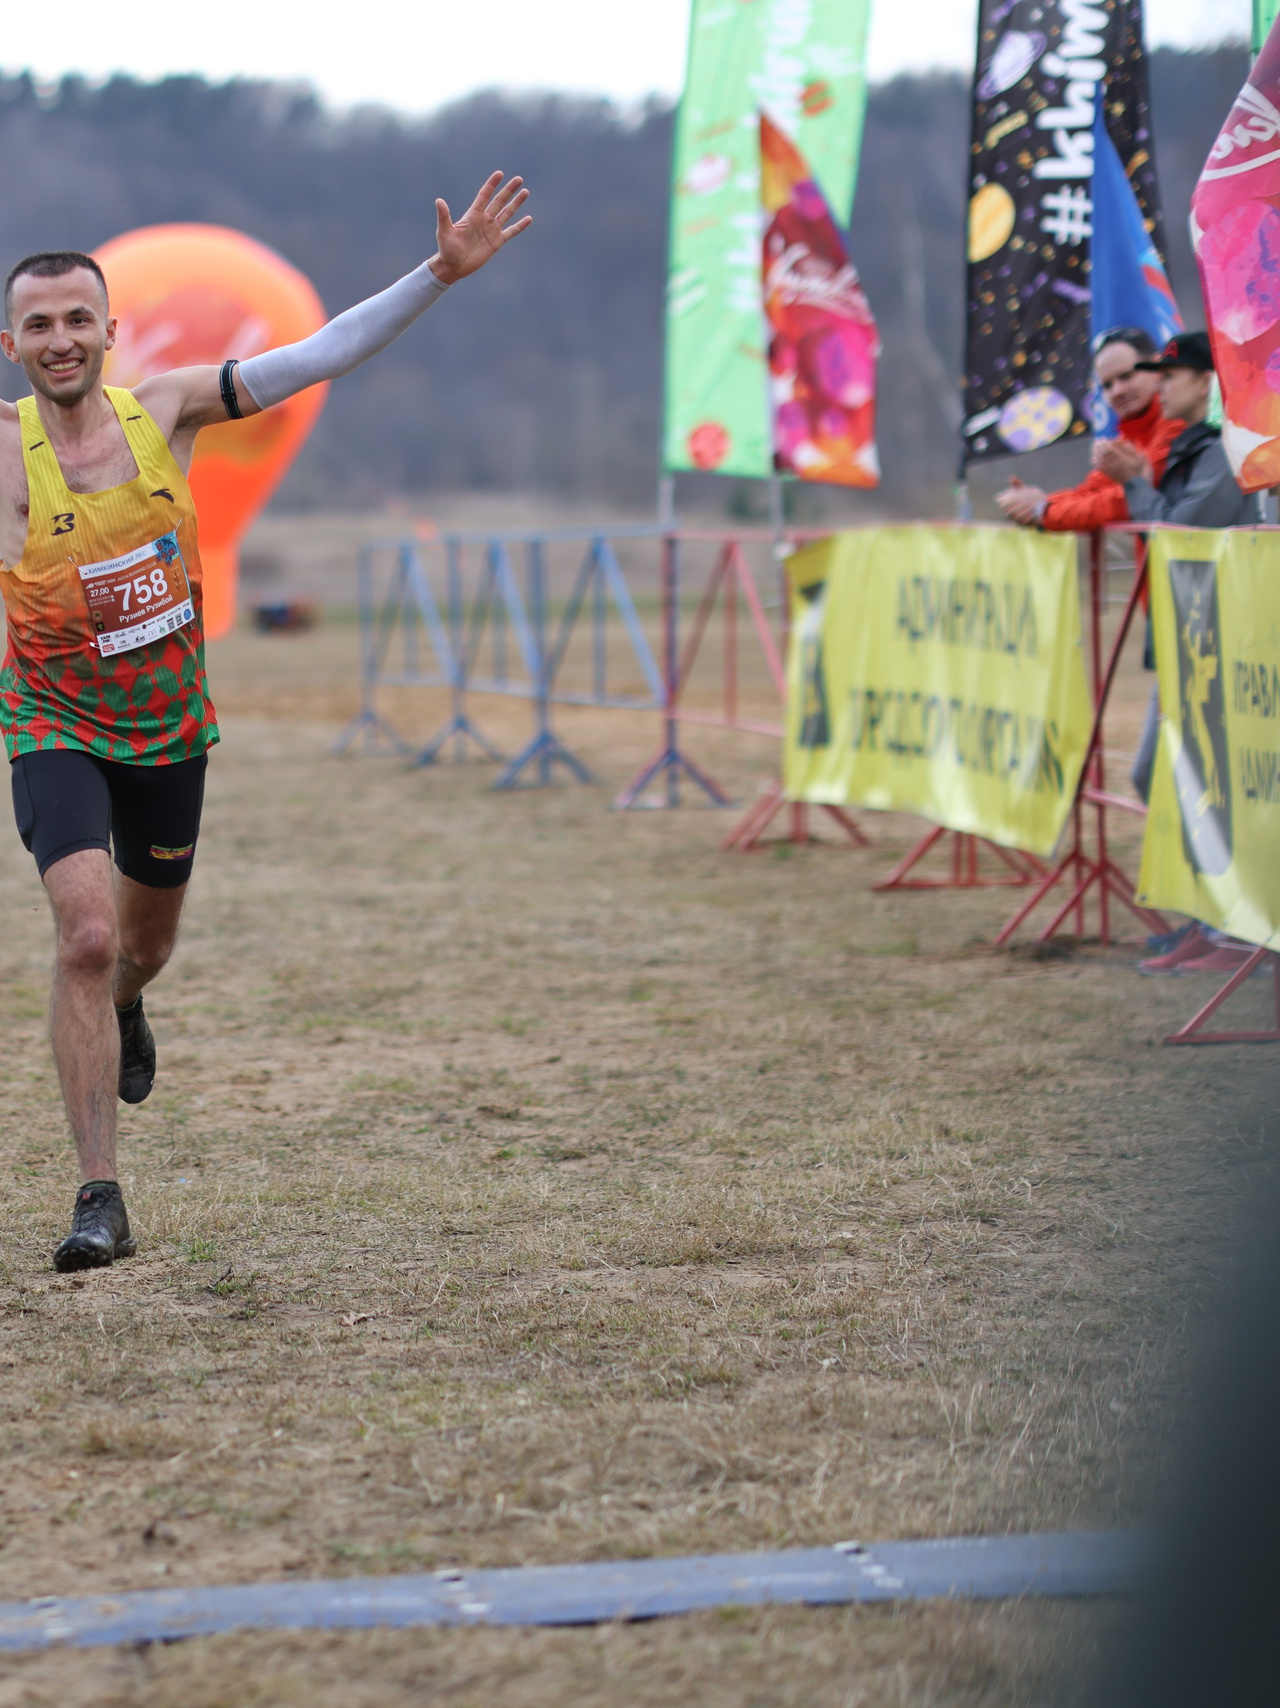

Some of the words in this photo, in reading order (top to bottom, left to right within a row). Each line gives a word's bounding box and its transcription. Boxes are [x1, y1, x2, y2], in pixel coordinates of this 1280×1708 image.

[87, 555, 134, 575] ХИМКИНСКИЙ
[135, 550, 147, 560] ЛЕС
[113, 568, 168, 611] 758
[119, 608, 146, 623] Рузиев
[146, 594, 174, 612] Рузибой
